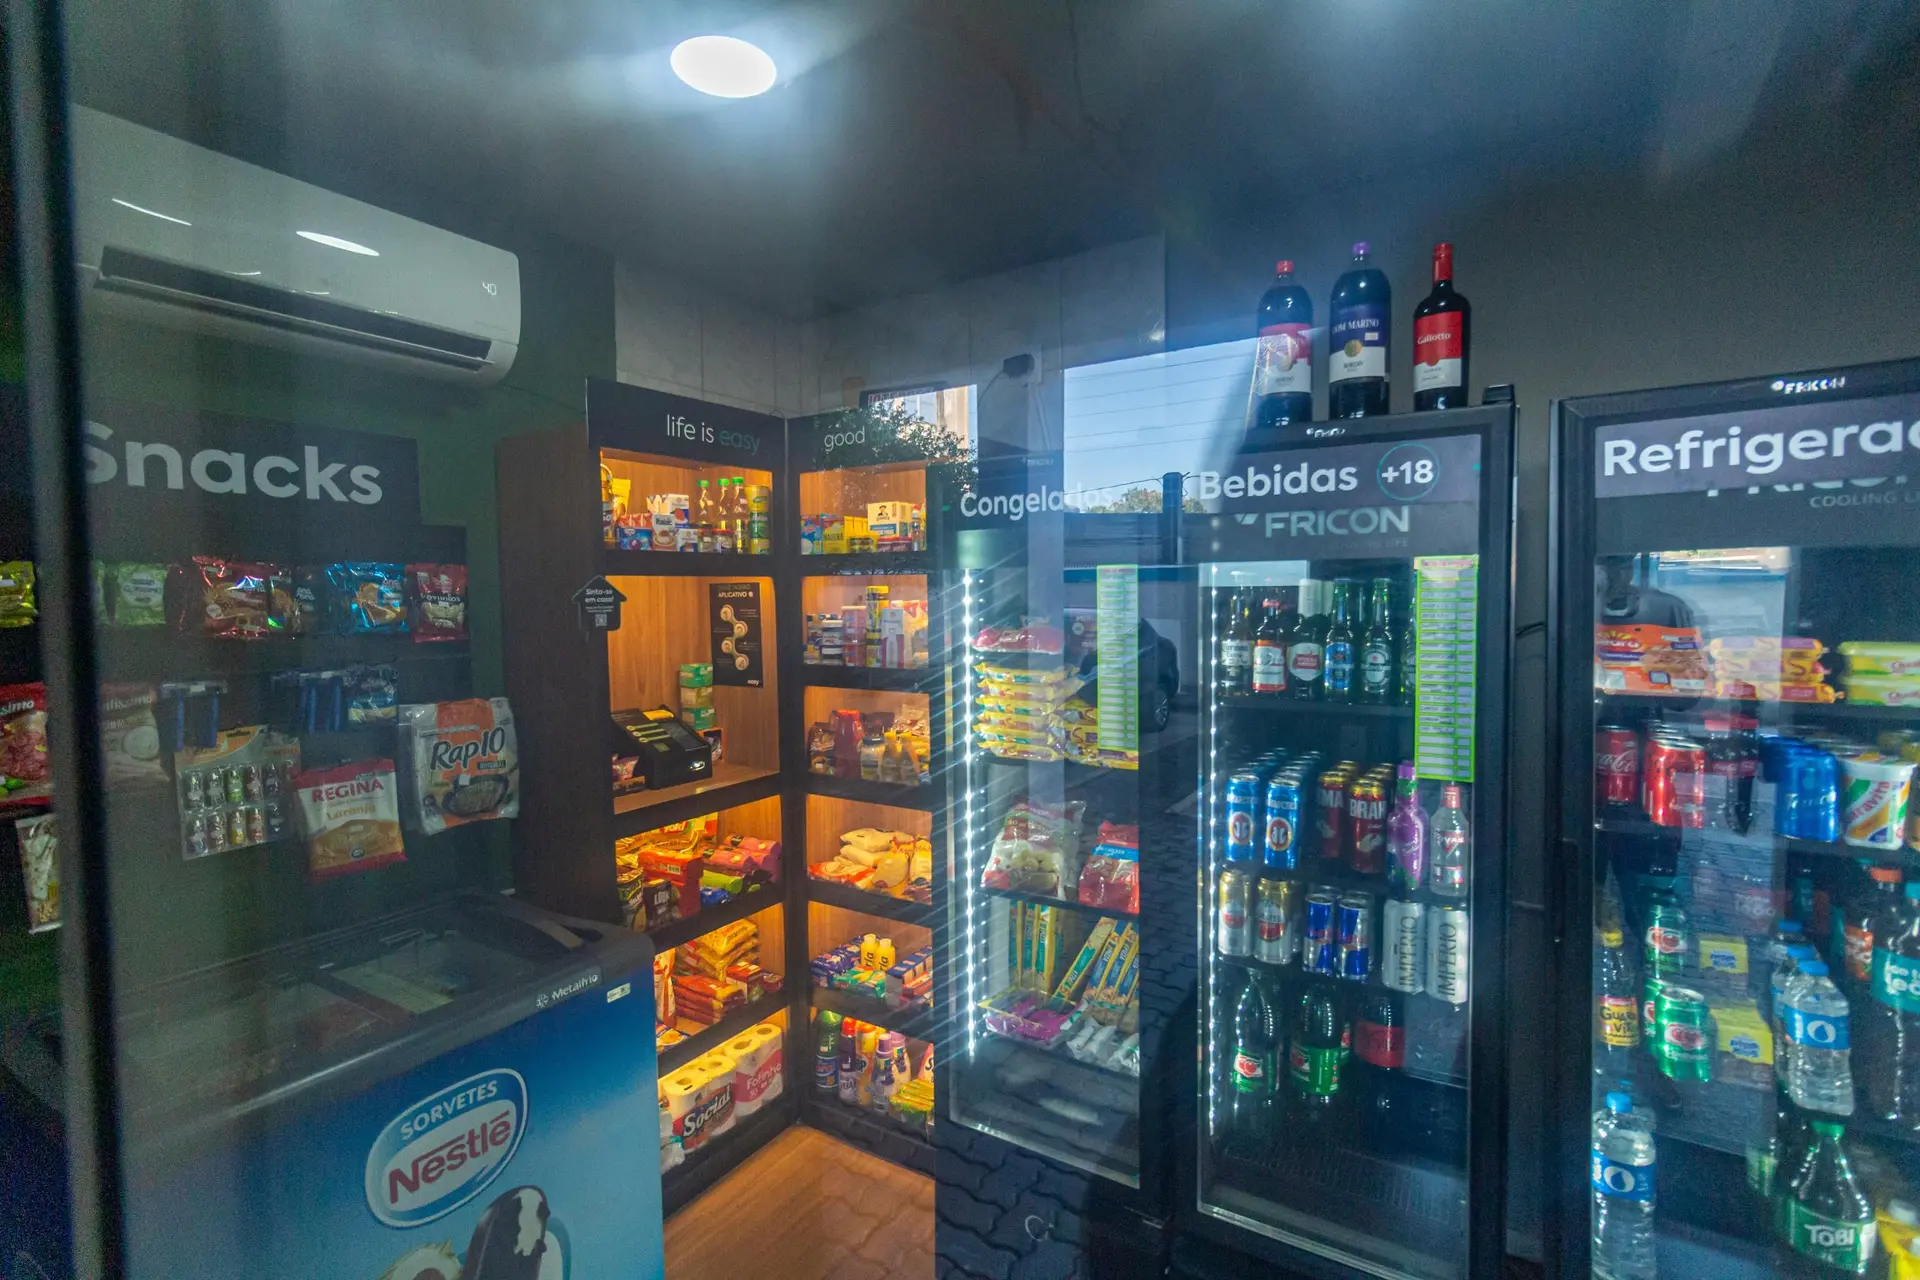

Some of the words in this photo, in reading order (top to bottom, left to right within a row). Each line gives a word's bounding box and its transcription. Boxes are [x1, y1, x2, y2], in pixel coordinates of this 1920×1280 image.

[1417, 333, 1452, 346] Galiotto
[666, 414, 696, 440] life
[701, 422, 715, 443] is
[719, 430, 760, 456] easy
[824, 425, 866, 452] good
[1604, 420, 1920, 477] Refrigera
[84, 419, 383, 506] Snacks
[1200, 462, 1358, 500] Bebidas
[1381, 459, 1434, 485] +18
[960, 482, 1114, 521] Congelados
[1809, 490, 1898, 510] COOLING
[1265, 505, 1410, 538] FRICON
[429, 726, 506, 771] Rap10
[312, 779, 384, 804] REGINA
[551, 974, 598, 1000] Metalfrio
[399, 1080, 498, 1141] SORVETES
[683, 1083, 732, 1137] Social
[1804, 1223, 1855, 1247] TOBI
